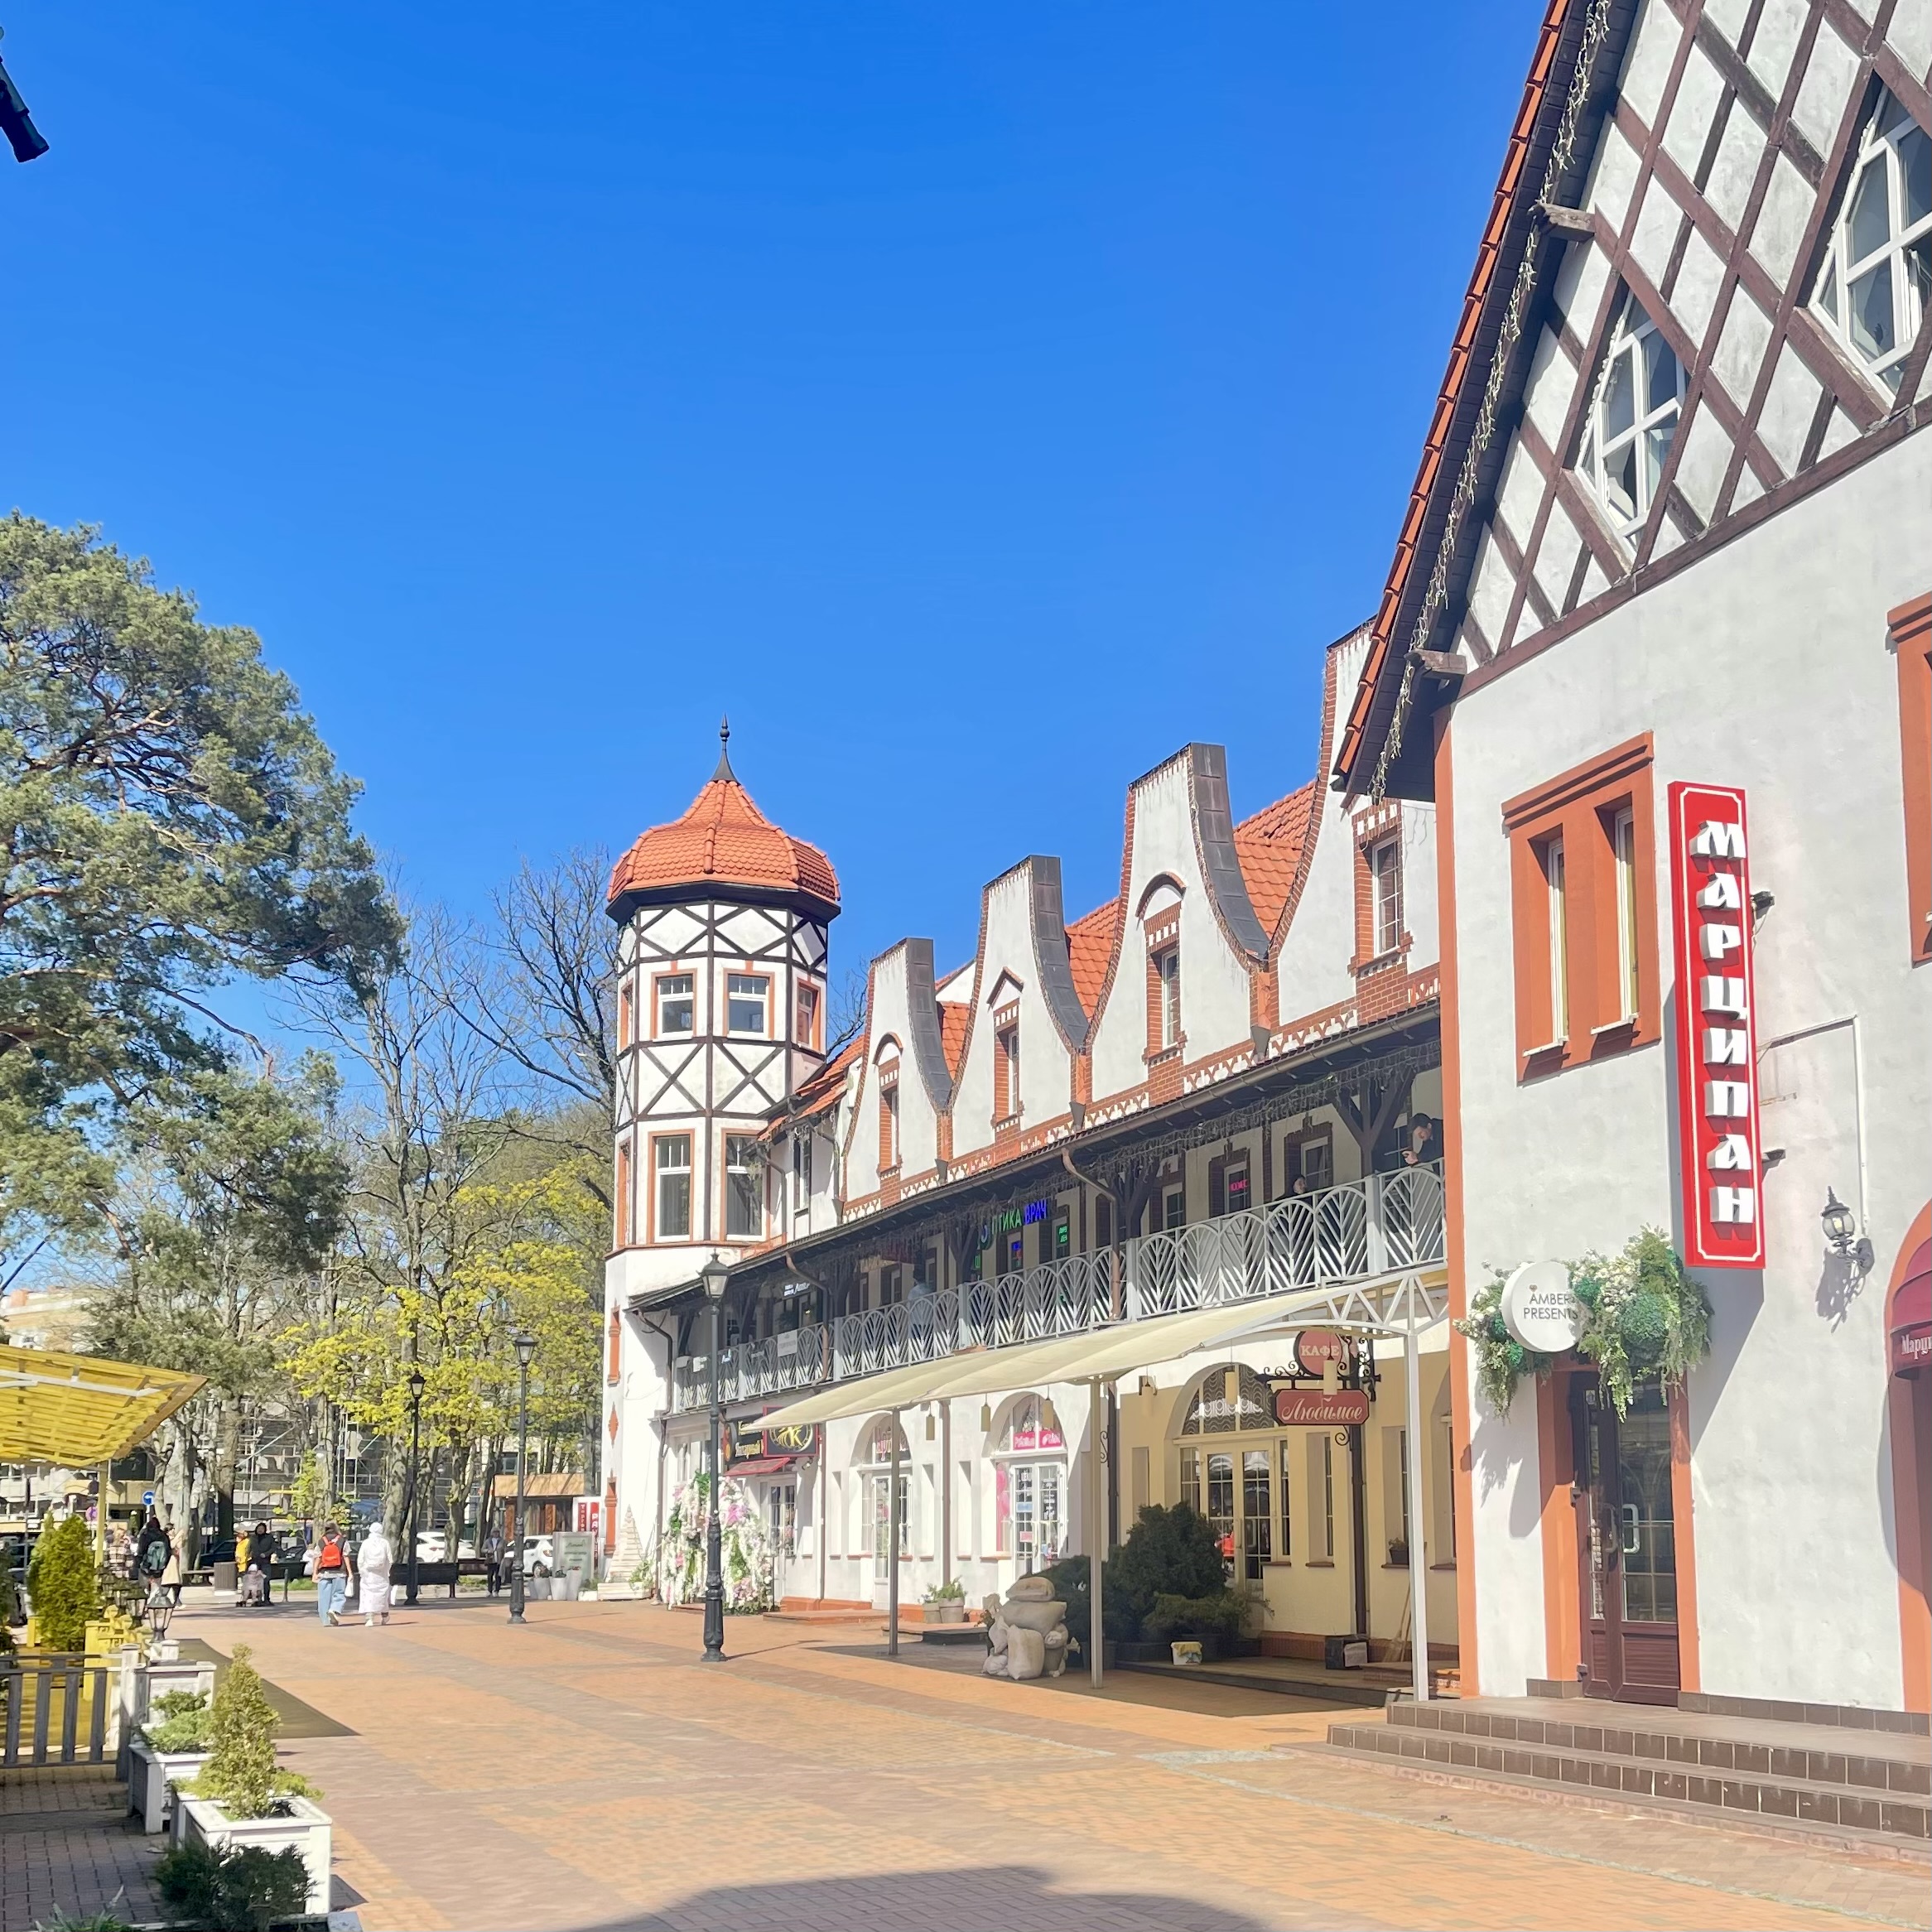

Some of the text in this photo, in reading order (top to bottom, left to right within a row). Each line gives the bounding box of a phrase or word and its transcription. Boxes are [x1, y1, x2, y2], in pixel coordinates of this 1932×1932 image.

[1690, 820, 1754, 1223] МАРЦИПАН
[1024, 1198, 1048, 1226] ВРАЧ
[1529, 1294, 1575, 1305] AMBER
[1523, 1308, 1578, 1320] PRESENTS
[1301, 1345, 1340, 1356] КАФЕ
[1281, 1396, 1363, 1421] Любимое
